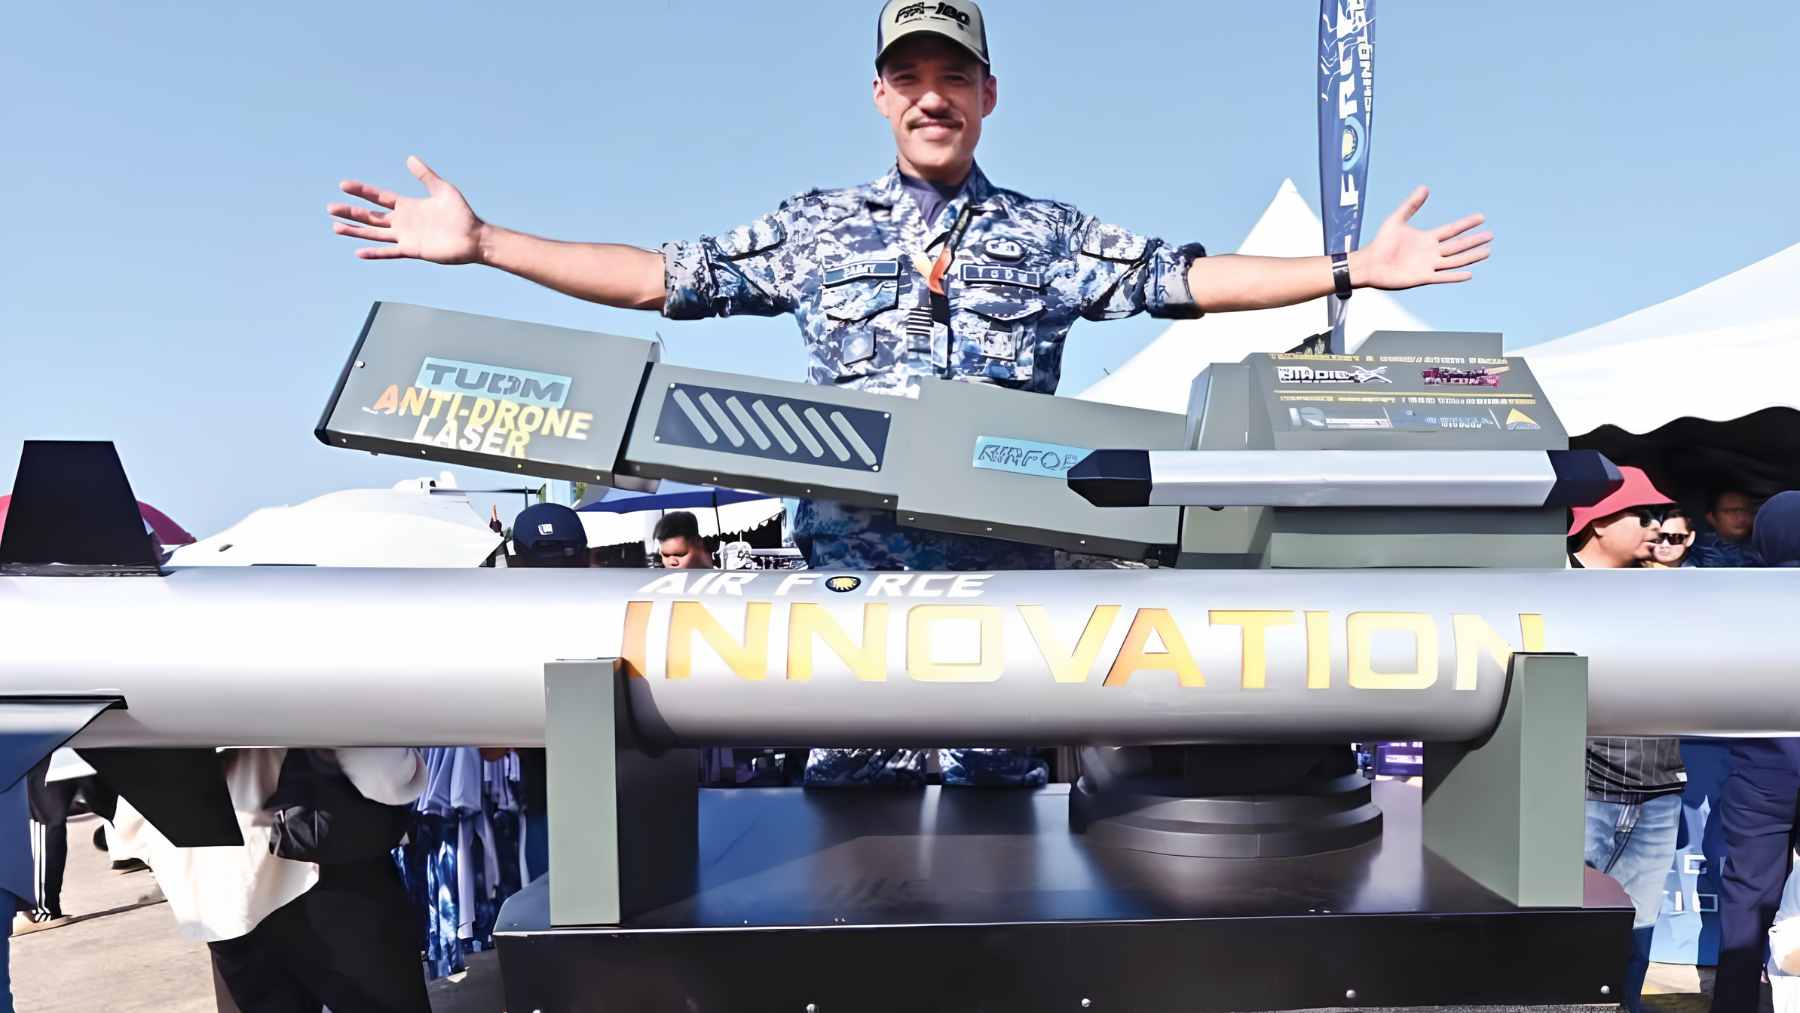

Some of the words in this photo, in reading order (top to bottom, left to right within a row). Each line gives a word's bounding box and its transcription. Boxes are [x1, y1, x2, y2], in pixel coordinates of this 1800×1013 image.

[425, 363, 564, 402] TUDM
[370, 384, 593, 441] ANTI-DRONE
[413, 414, 531, 459] LASER
[978, 444, 1080, 470] AIRFOR
[638, 571, 755, 596] AIR
[620, 601, 1545, 691] INNOVATION
